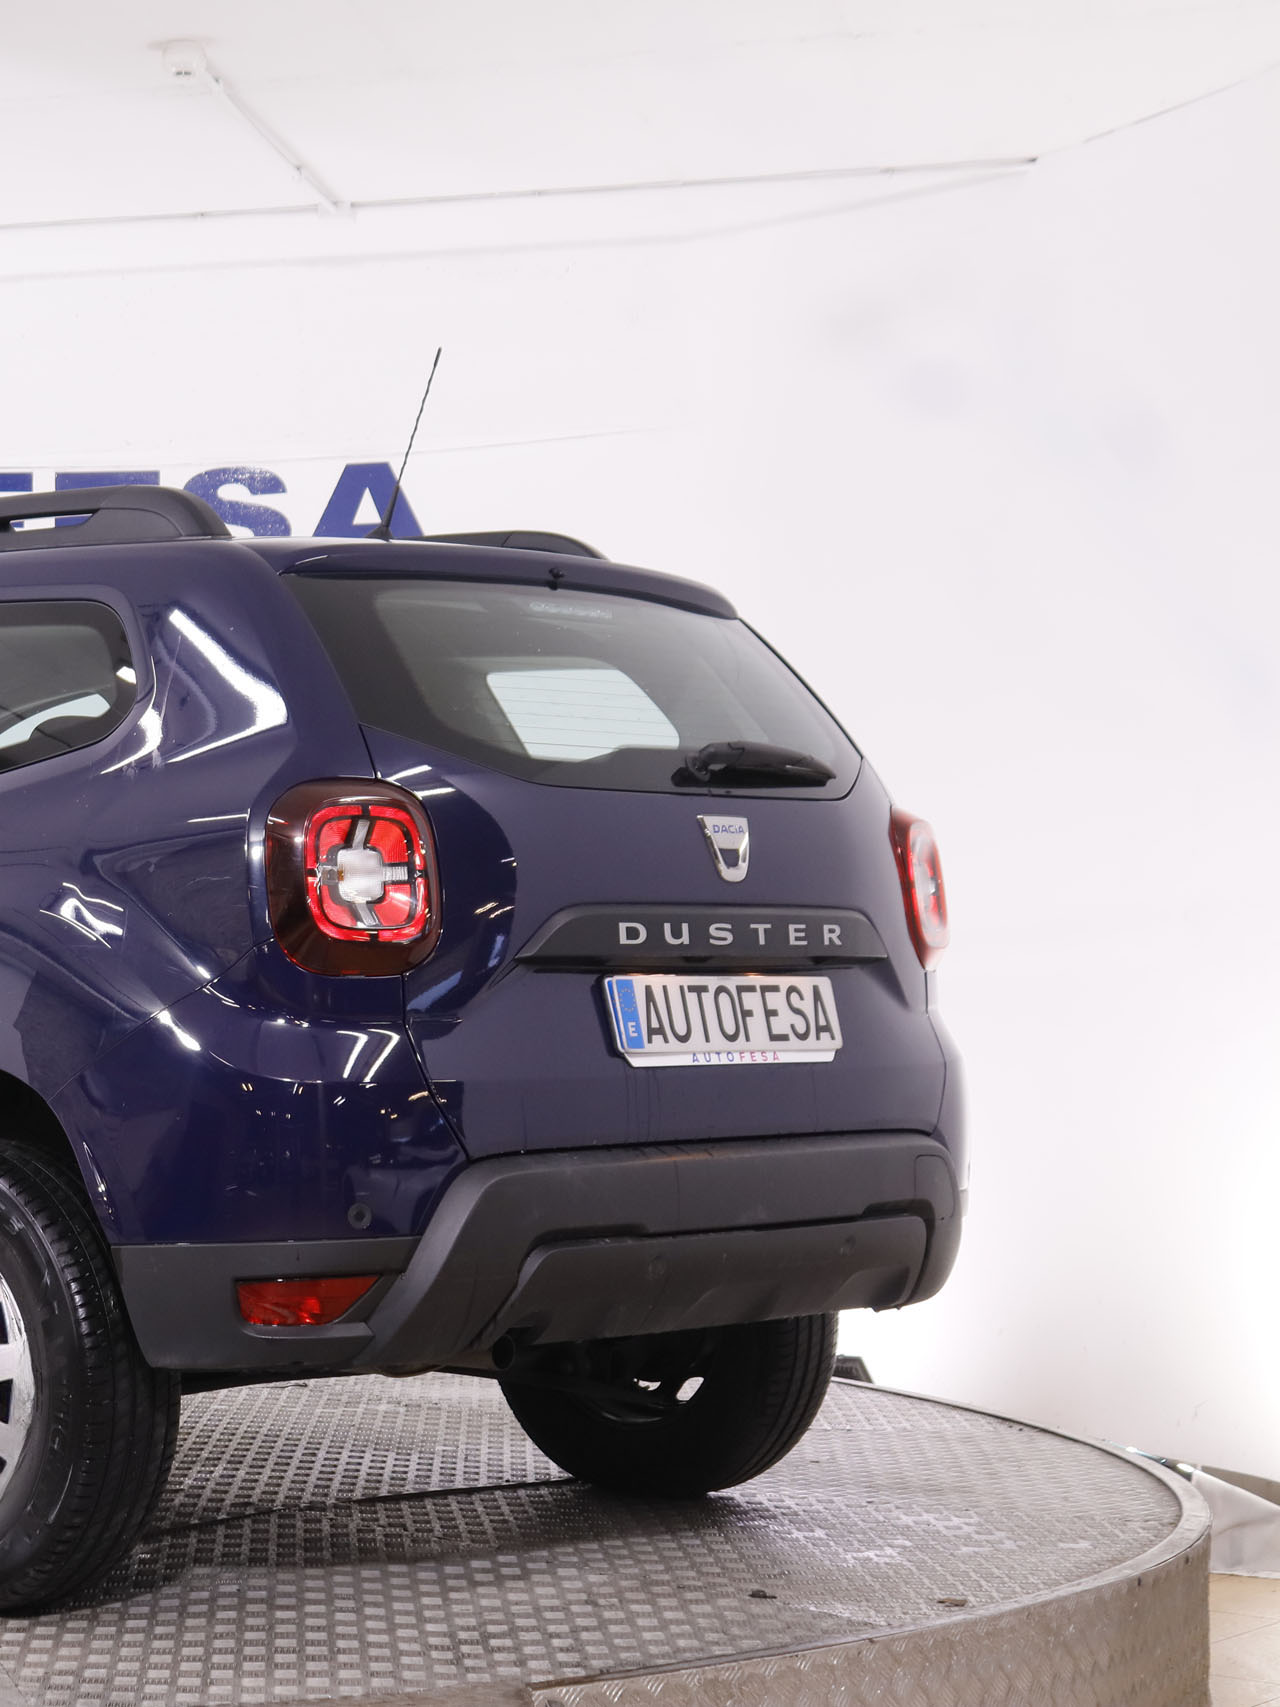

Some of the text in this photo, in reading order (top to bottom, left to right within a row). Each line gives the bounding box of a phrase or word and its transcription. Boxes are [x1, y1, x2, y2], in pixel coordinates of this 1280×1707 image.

[618, 921, 843, 946] DUSTER
[644, 984, 836, 1044] AUTOFESA
[627, 1021, 638, 1037] E
[692, 1051, 780, 1064] AUTOFESA
